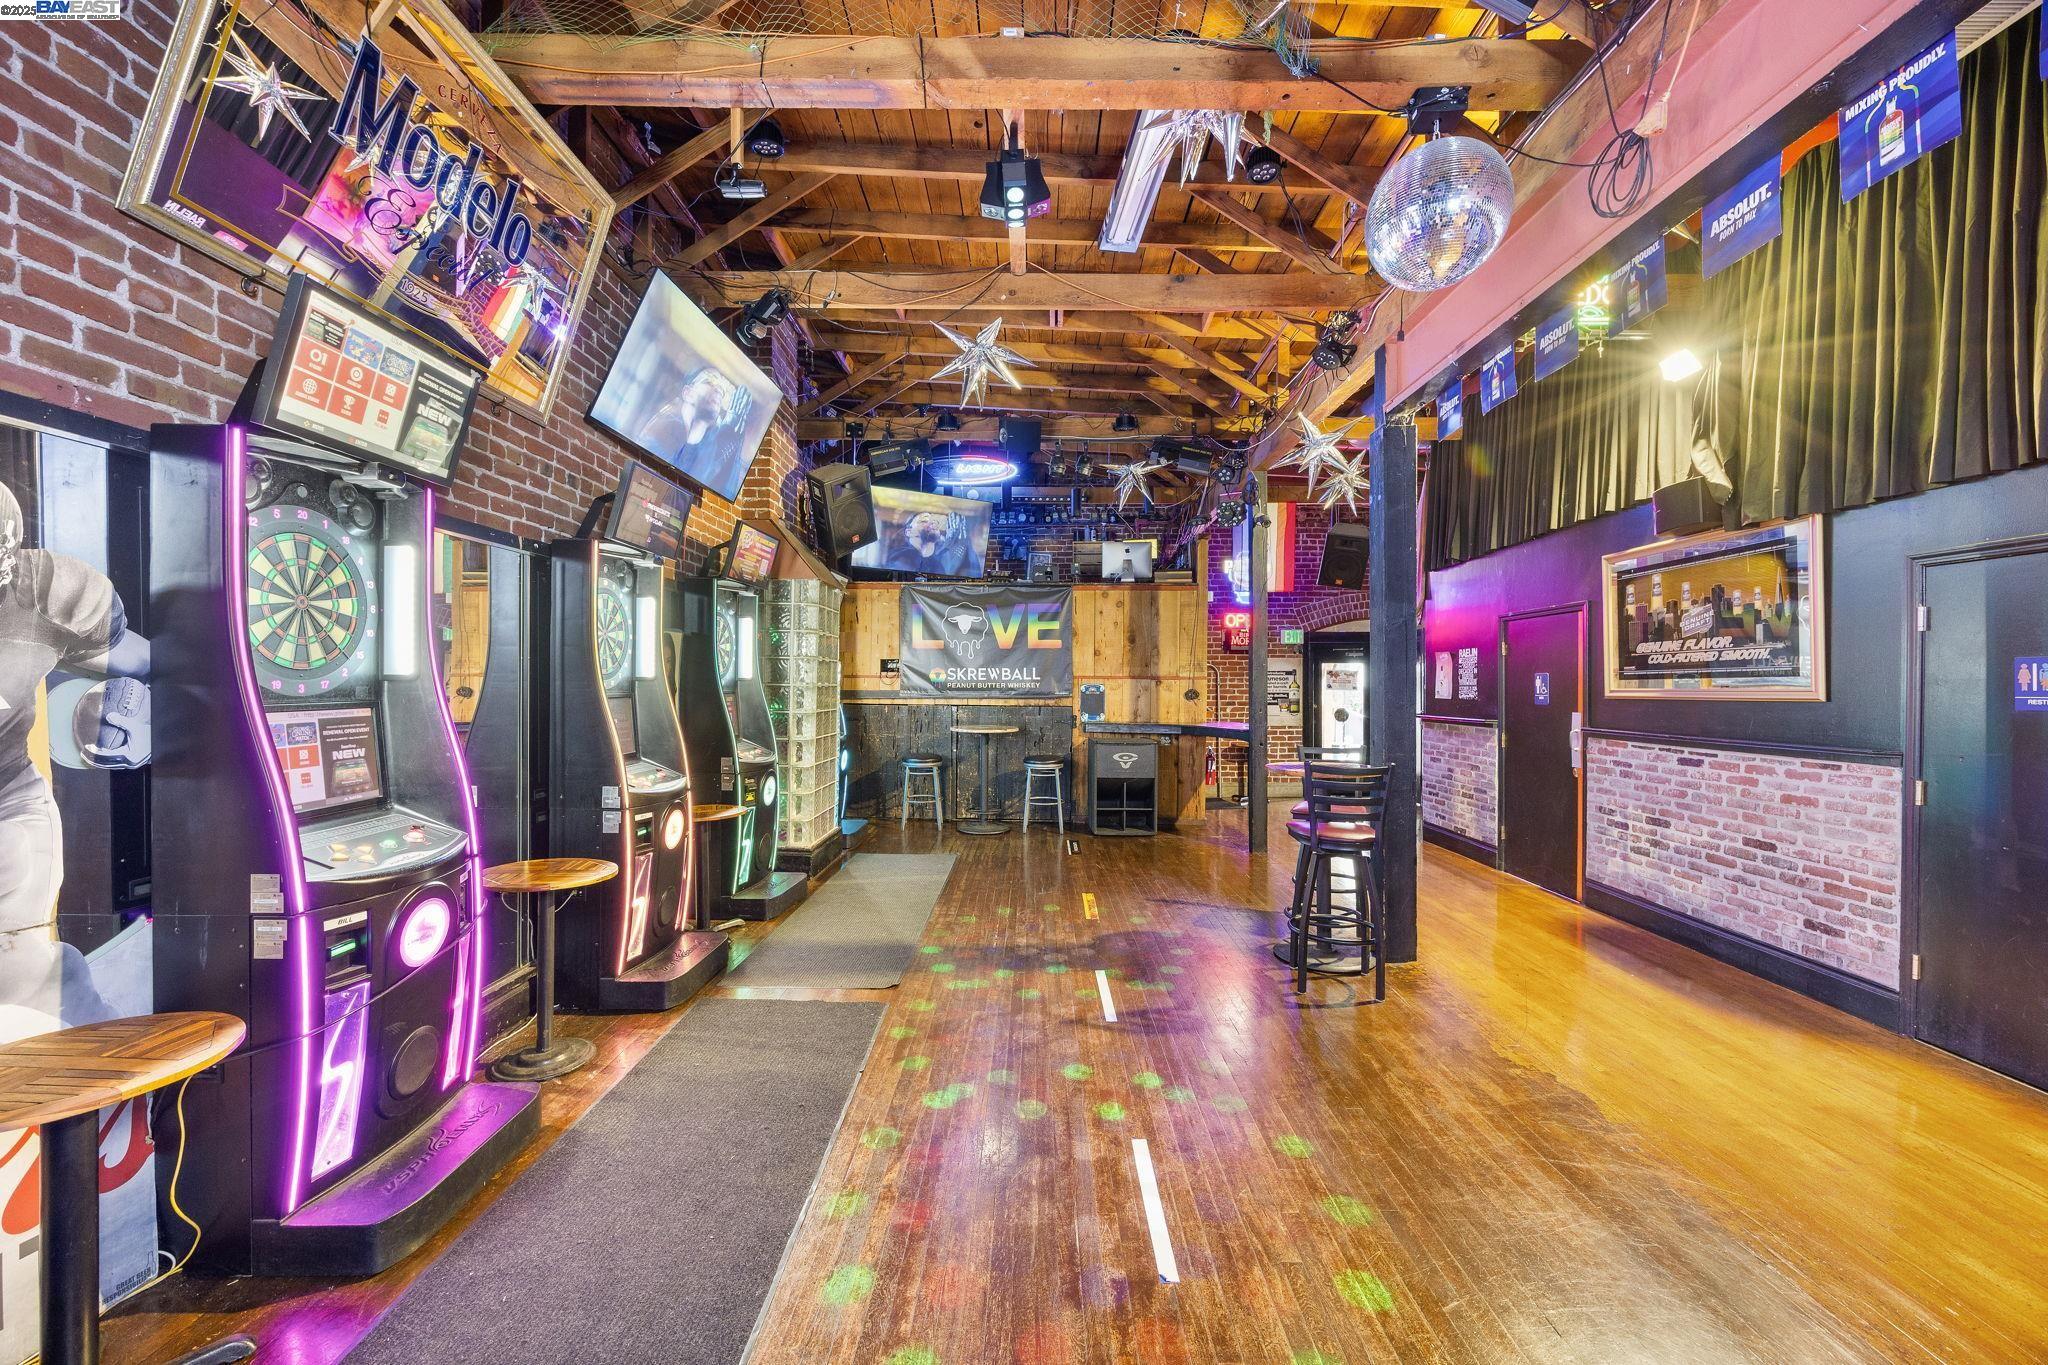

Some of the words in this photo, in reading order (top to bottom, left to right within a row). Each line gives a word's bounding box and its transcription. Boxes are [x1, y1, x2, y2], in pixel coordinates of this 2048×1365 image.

[1845, 84, 1887, 123] MIXING
[1888, 42, 1947, 92] PROUDLY.
[438, 84, 502, 154] CERVEZA
[328, 34, 532, 267] Modelo
[1743, 208, 1758, 225] MIX
[400, 278, 429, 303] 1925
[417, 403, 452, 427] NEW
[274, 509, 280, 519] 5
[297, 509, 308, 520] 20
[323, 519, 328, 529] 1
[342, 536, 350, 545] 18
[358, 556, 364, 566] 4
[367, 580, 374, 589] 13
[370, 605, 376, 614] 6
[1680, 611, 1714, 628] GENUINE
[1684, 619, 1711, 632] DRAFT
[366, 629, 374, 638] 10
[1284, 630, 1301, 643] EXIT
[1636, 639, 1682, 654] GENUINE
[1682, 635, 1734, 650] FLAVOR.
[357, 651, 364, 660] 15
[1647, 652, 1718, 664] COLD-FILTERED
[1719, 648, 1770, 661] SMOOTH.
[342, 668, 348, 677] 2
[947, 667, 1041, 681] SKREWBALL
[272, 680, 282, 690] 19
[299, 684, 305, 694] 3
[321, 680, 330, 690] 17
[332, 747, 366, 760] NEW
[337, 916, 353, 926] BILL
[116, 1276, 135, 1291] GREAT
